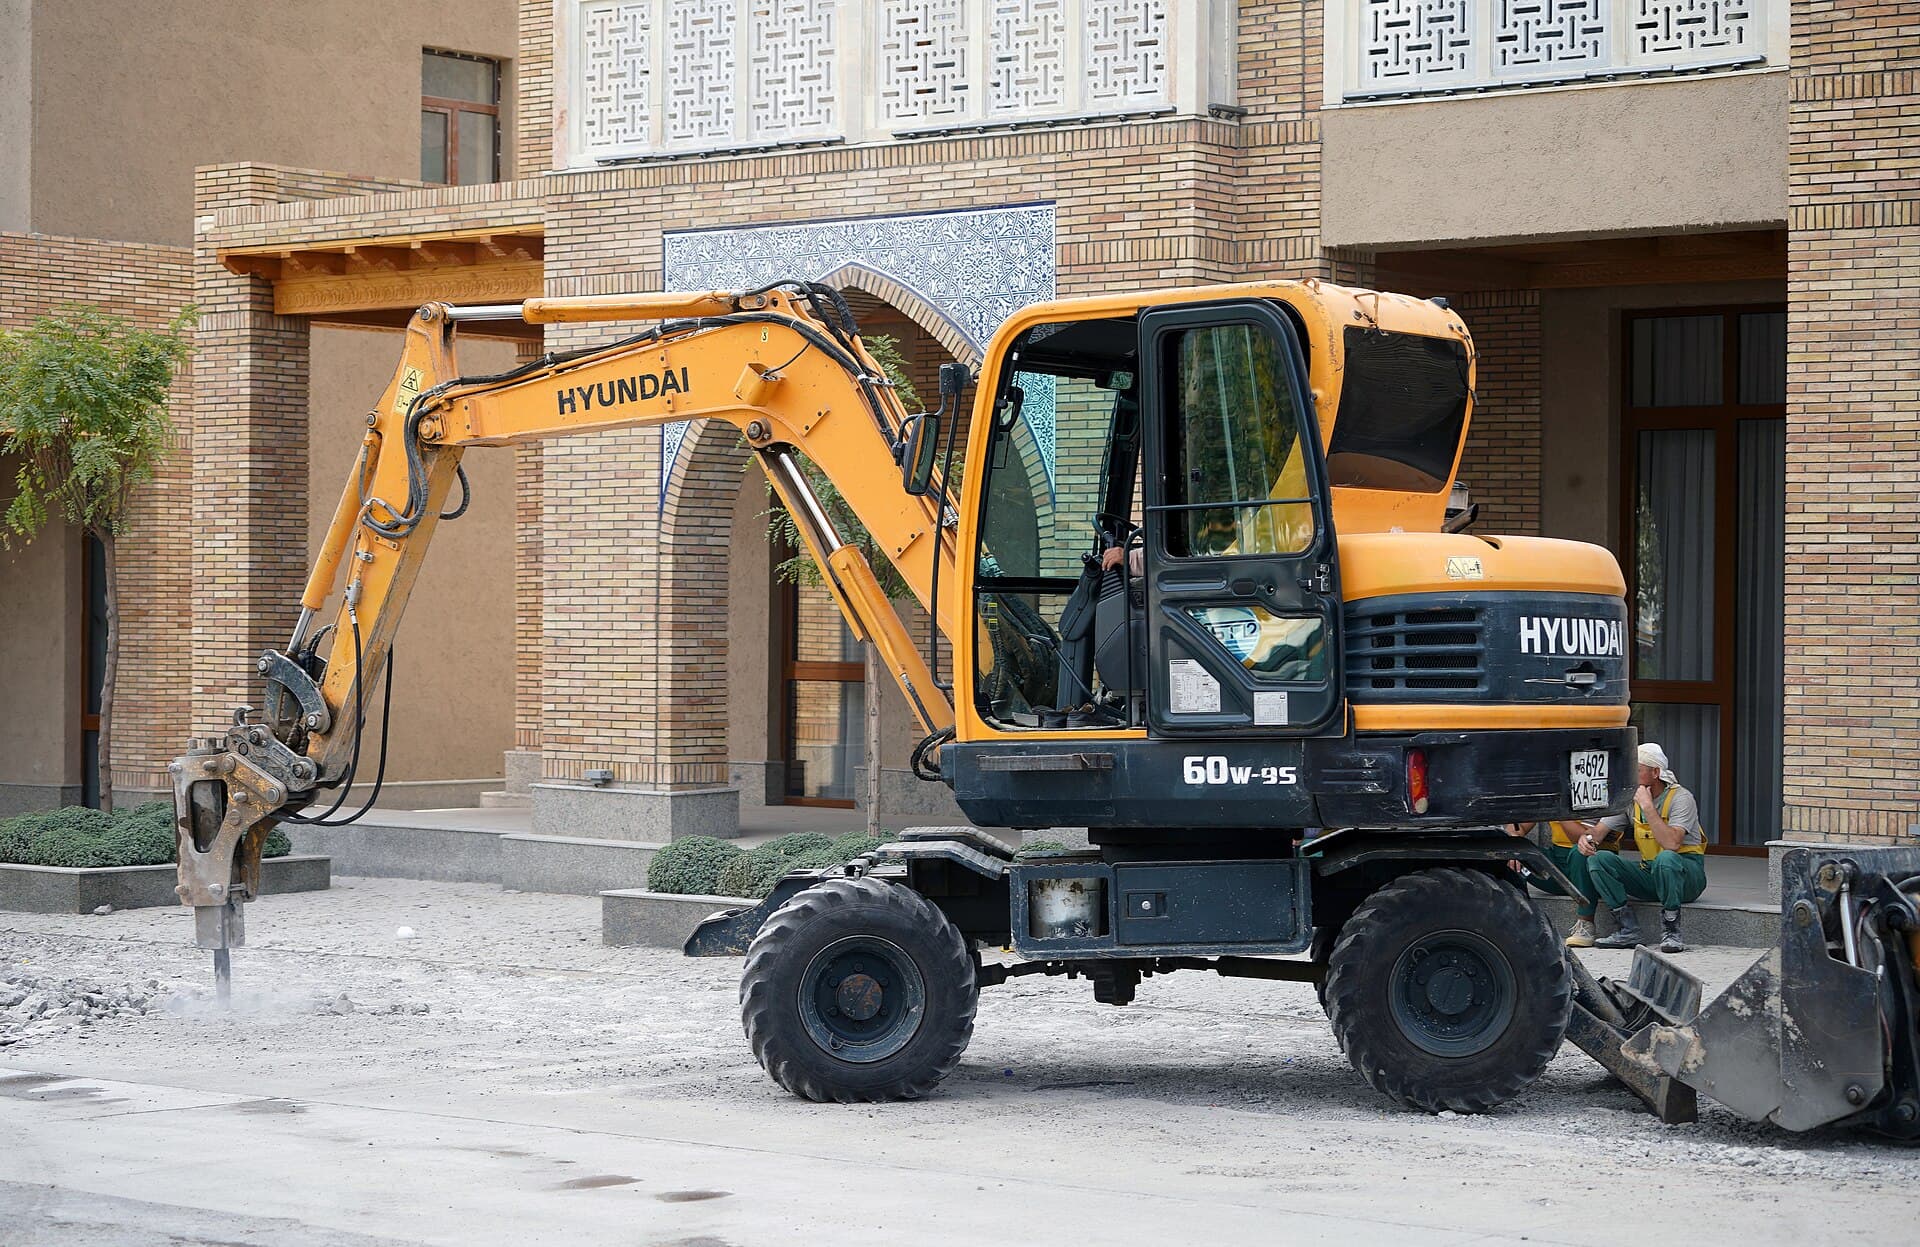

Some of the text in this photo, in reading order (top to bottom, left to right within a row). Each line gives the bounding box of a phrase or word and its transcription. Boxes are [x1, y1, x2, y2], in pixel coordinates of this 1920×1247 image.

[557, 367, 690, 415] HYUNDAI
[1519, 616, 1624, 656] HYUNDAI
[1586, 754, 1605, 777] 692
[1572, 781, 1602, 804] KA 01
